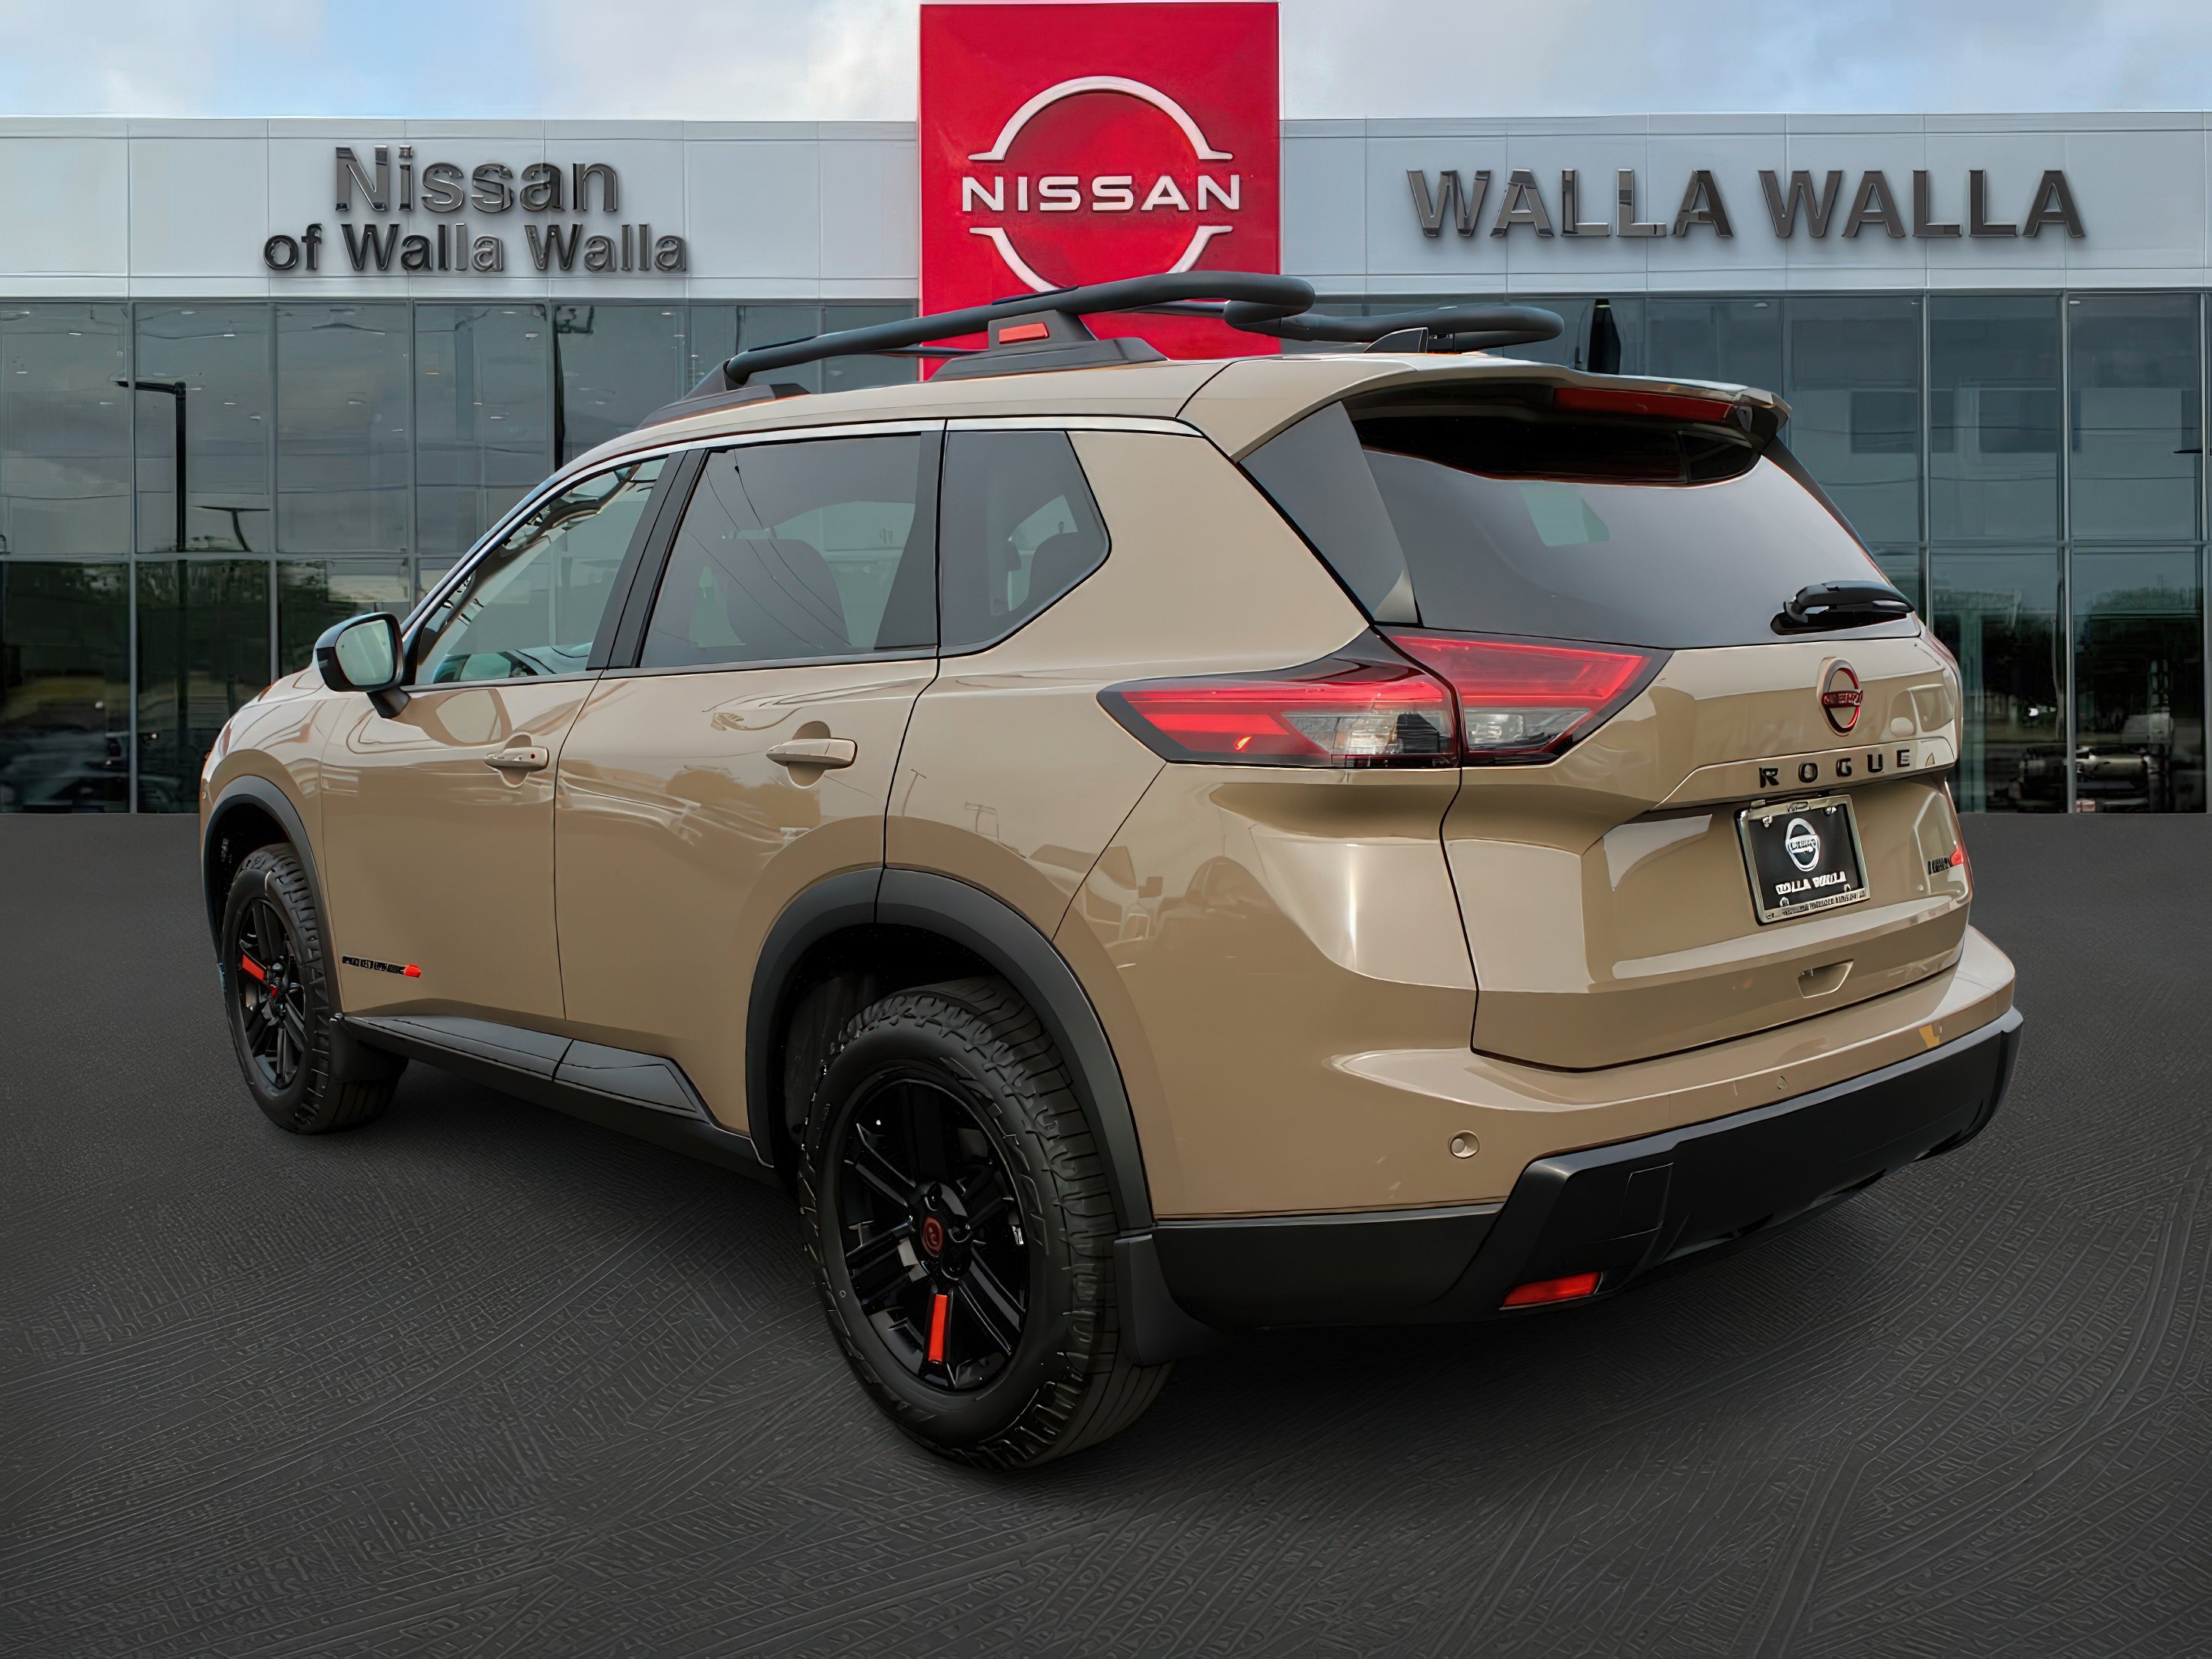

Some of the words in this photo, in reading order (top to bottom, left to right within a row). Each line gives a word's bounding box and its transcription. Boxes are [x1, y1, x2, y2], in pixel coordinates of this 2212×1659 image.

[336, 144, 618, 212] Nissan
[962, 175, 1240, 211] NISSAN
[1406, 168, 1734, 238] WALLA
[1758, 168, 2087, 238] WALLA
[263, 223, 323, 271] of
[341, 223, 504, 272] Walla
[524, 223, 688, 272] Walla
[1759, 749, 1910, 788] ROGUE
